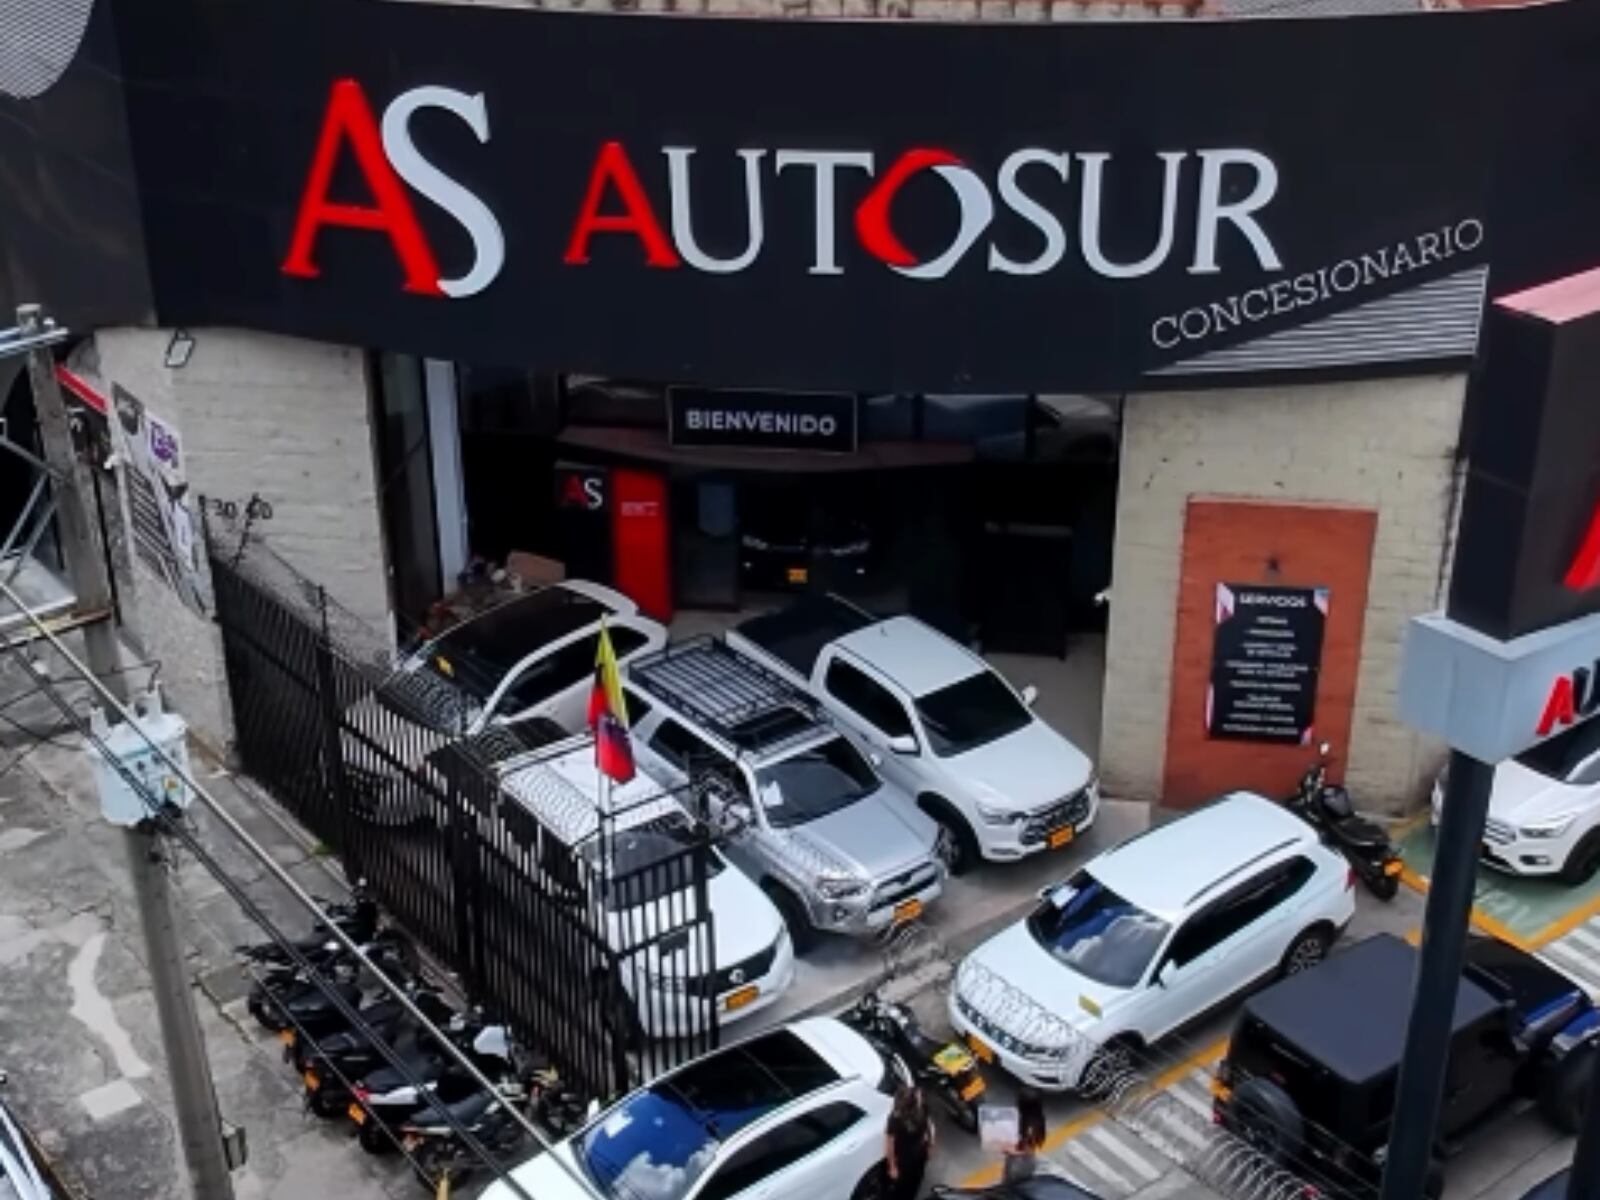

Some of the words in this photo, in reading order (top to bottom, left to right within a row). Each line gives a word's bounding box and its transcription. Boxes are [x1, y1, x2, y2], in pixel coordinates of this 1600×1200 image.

[281, 77, 505, 298] AS
[563, 141, 1282, 279] AUTOSUR
[1151, 218, 1484, 349] CONCESIONARIO
[685, 409, 837, 436] BIENVENIDO
[561, 474, 603, 510] AS
